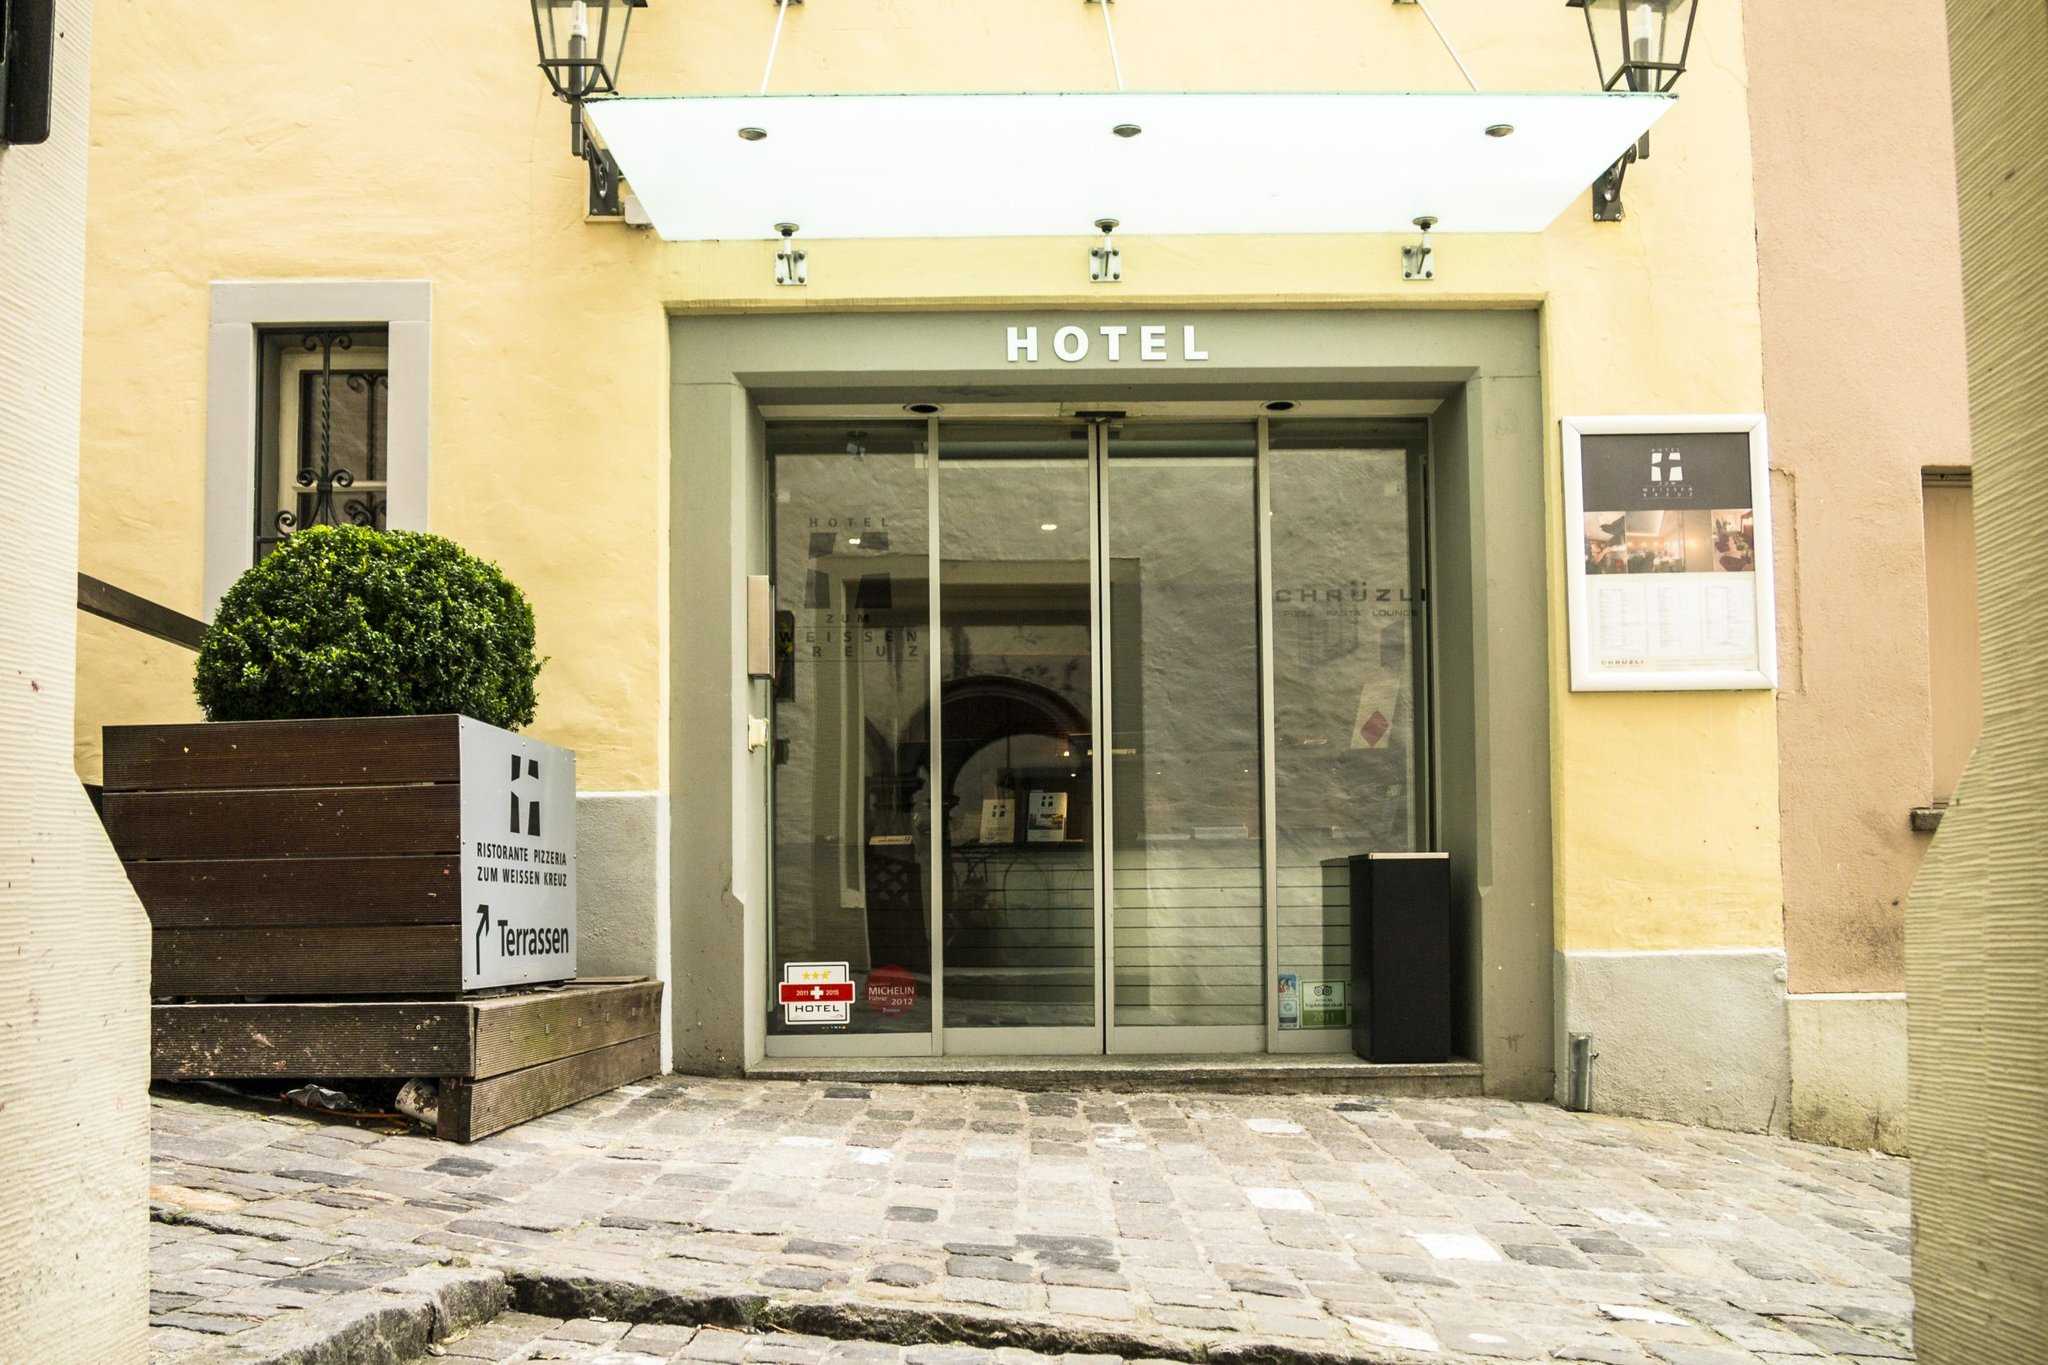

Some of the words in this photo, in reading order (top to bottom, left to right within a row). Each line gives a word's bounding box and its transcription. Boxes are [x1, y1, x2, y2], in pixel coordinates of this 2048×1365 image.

[1006, 325, 1209, 362] HOTEL
[809, 517, 889, 528] HOTEL
[1274, 580, 1426, 602] CHRÜZLI
[825, 614, 870, 624] ZUM
[779, 631, 917, 643] WEISSEN
[476, 842, 529, 862] RISTORANTE
[533, 849, 567, 866] PIZZERIA
[477, 866, 498, 882] ZUM
[502, 868, 540, 885] WEISSEN
[543, 872, 567, 887] KREUZ
[497, 919, 569, 957] Terrassen
[868, 986, 915, 996] MICHELIN
[794, 1004, 840, 1013] HOTEL
